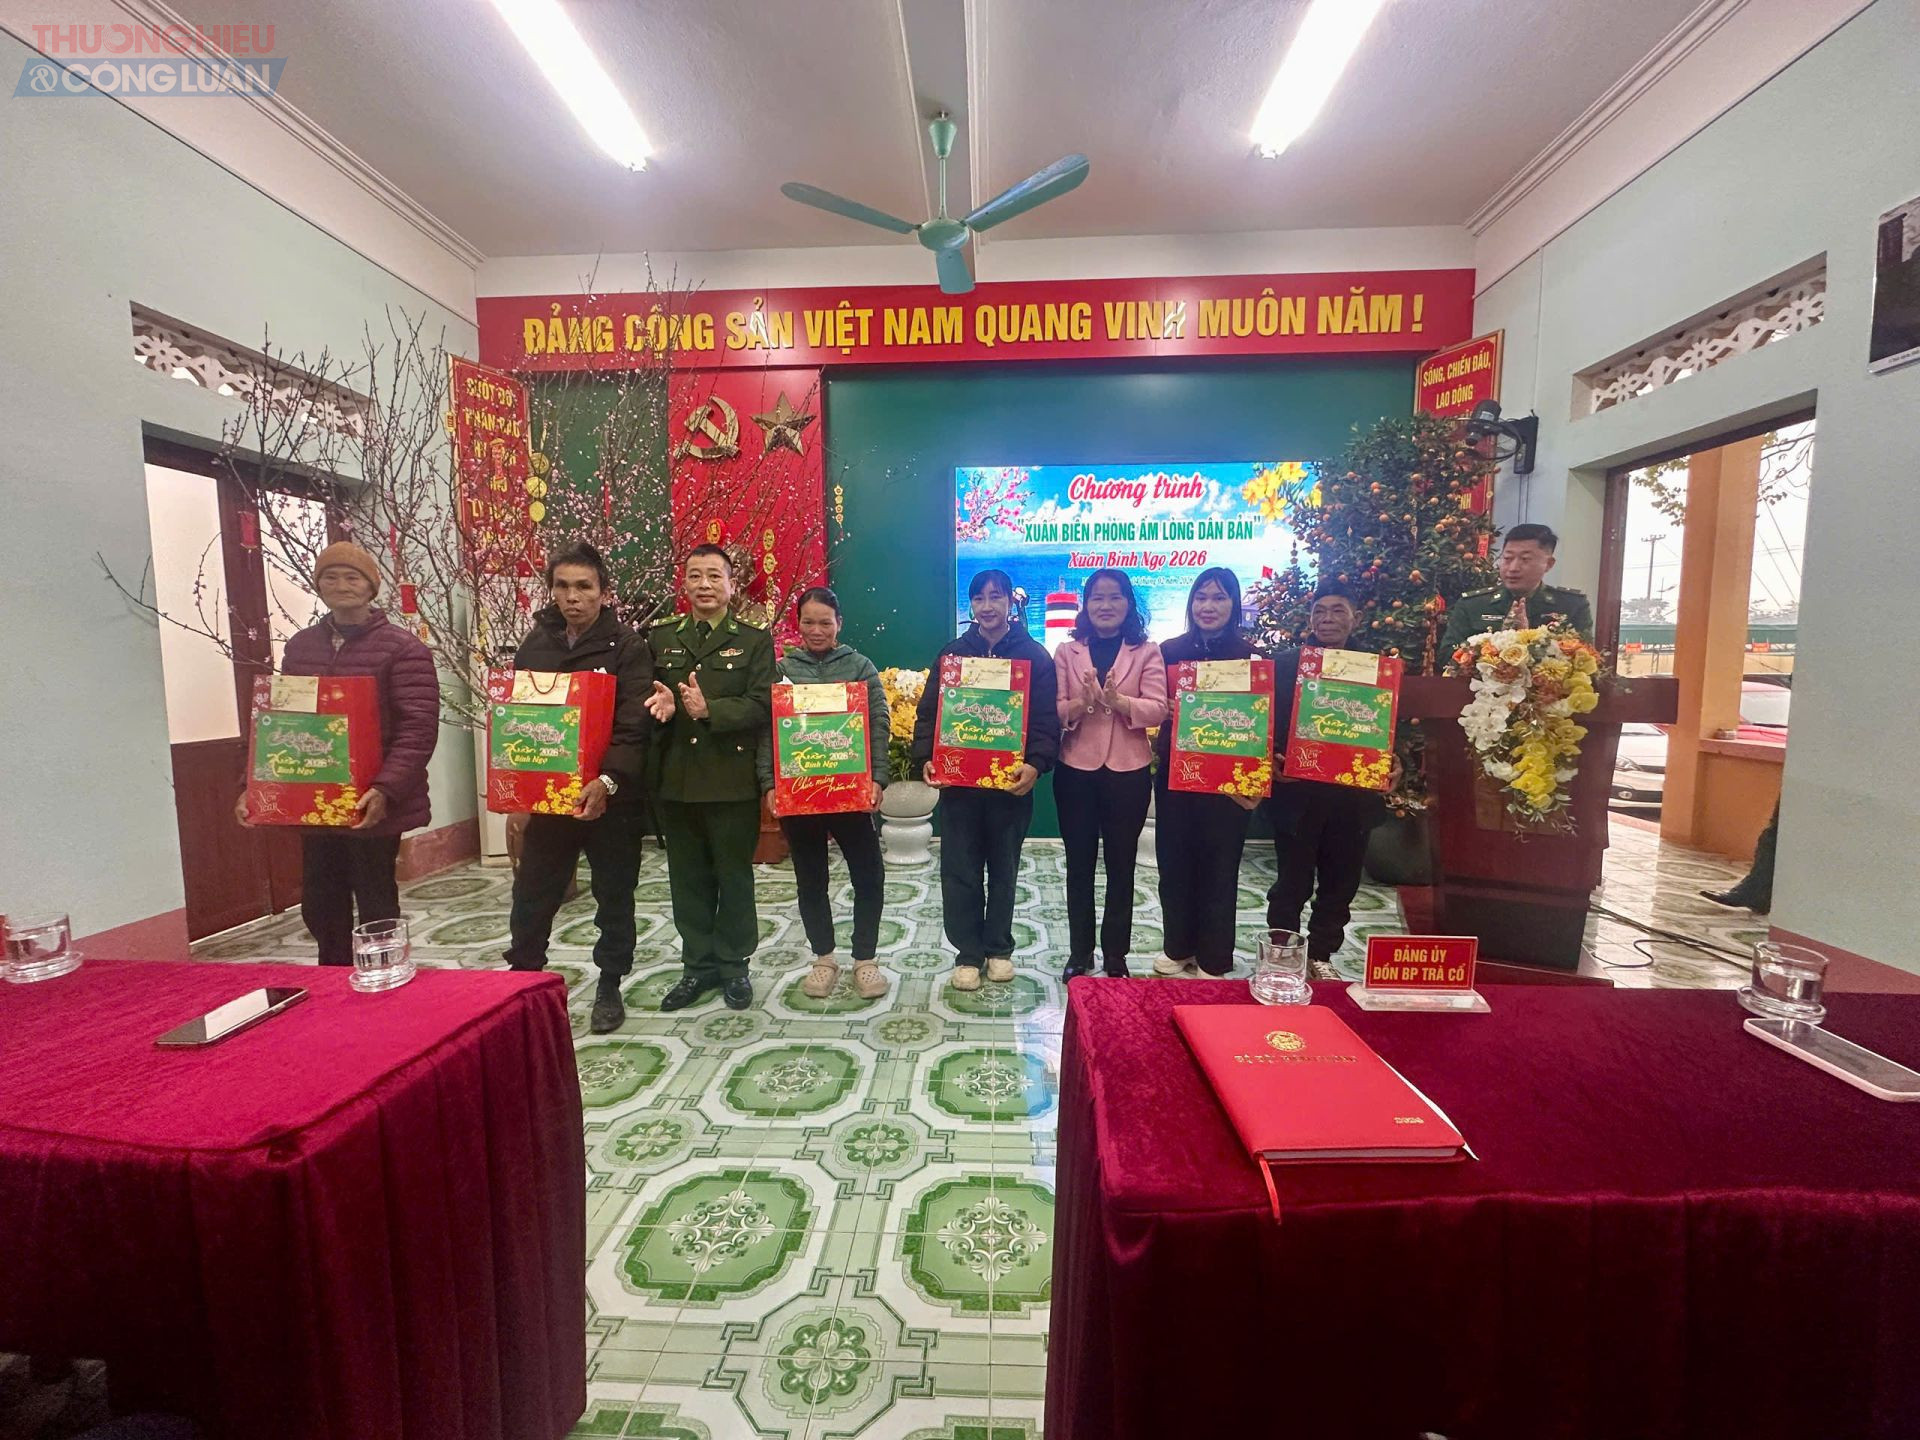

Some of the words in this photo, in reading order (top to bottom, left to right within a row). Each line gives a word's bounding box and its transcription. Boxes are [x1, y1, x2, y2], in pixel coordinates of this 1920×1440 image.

[523, 302, 614, 355] ĐẢNG
[625, 303, 715, 359] CỘNG
[725, 297, 794, 351] SẢN
[803, 300, 874, 355] VIỆT
[884, 304, 963, 347] NAM
[974, 301, 1092, 348] QUANG
[1103, 299, 1186, 341] VINH
[1199, 287, 1306, 338] MUÔN
[1317, 286, 1402, 335] NĂM
[1422, 361, 1445, 387] SỐNG,
[1447, 353, 1471, 379] CHIẾN
[1472, 346, 1491, 373] ĐẤU,
[1435, 390, 1450, 410] LAO
[1451, 384, 1473, 407] ĐỘNG
[1070, 475, 1148, 508] Chương
[1153, 474, 1204, 499] trình
[1062, 517, 1090, 542] BIÊN
[1094, 516, 1135, 542] PHÒNG
[1162, 516, 1194, 541] LÒNG
[1198, 516, 1226, 541] DÂN
[1069, 551, 1104, 568] Xuân
[1106, 550, 1138, 567] Bính
[1141, 551, 1166, 570] Ngọ
[1169, 550, 1207, 567] 2026
[1394, 944, 1428, 963] ĐẢNG
[1431, 944, 1447, 963] ỦY
[1401, 967, 1418, 981] BP
[1422, 965, 1445, 981] TRÀ
[1448, 963, 1466, 981] CỔ
